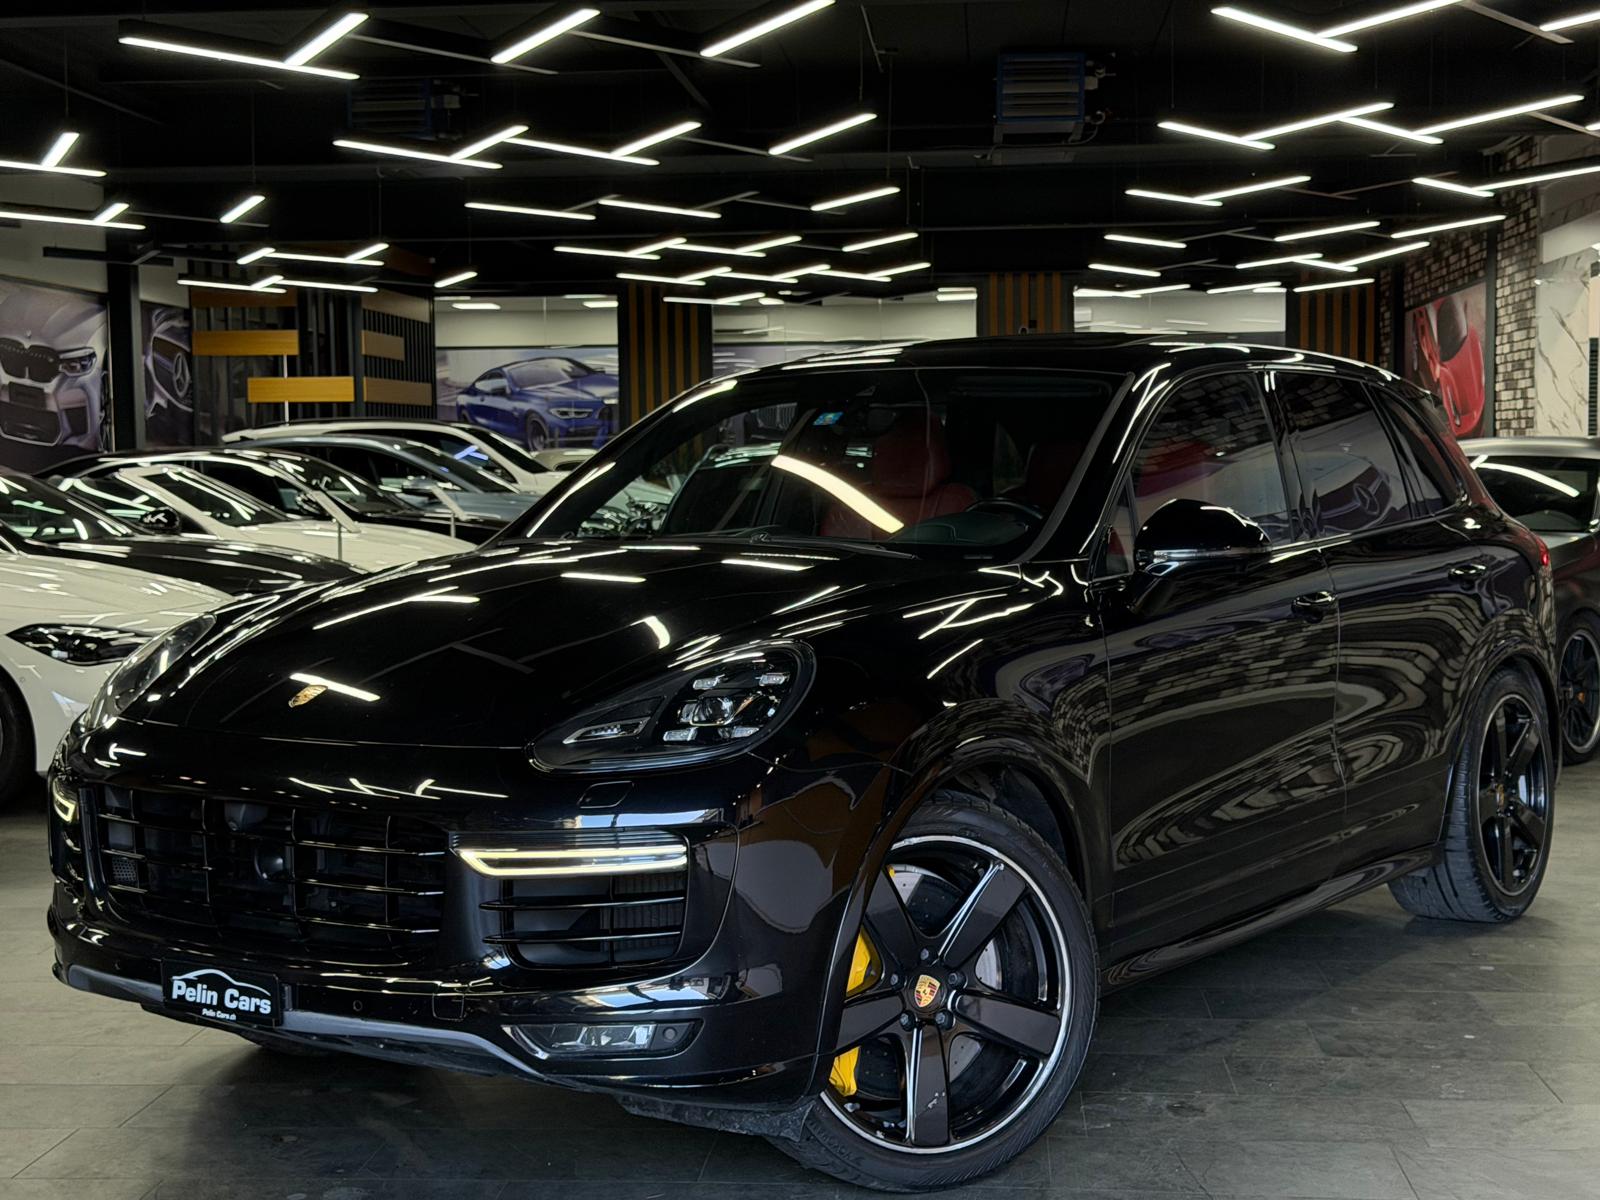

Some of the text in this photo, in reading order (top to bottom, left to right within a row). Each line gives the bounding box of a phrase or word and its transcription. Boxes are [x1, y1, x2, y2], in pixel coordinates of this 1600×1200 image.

[172, 980, 271, 1014] Pelin Cars
[202, 1008, 216, 1017] Pelin
